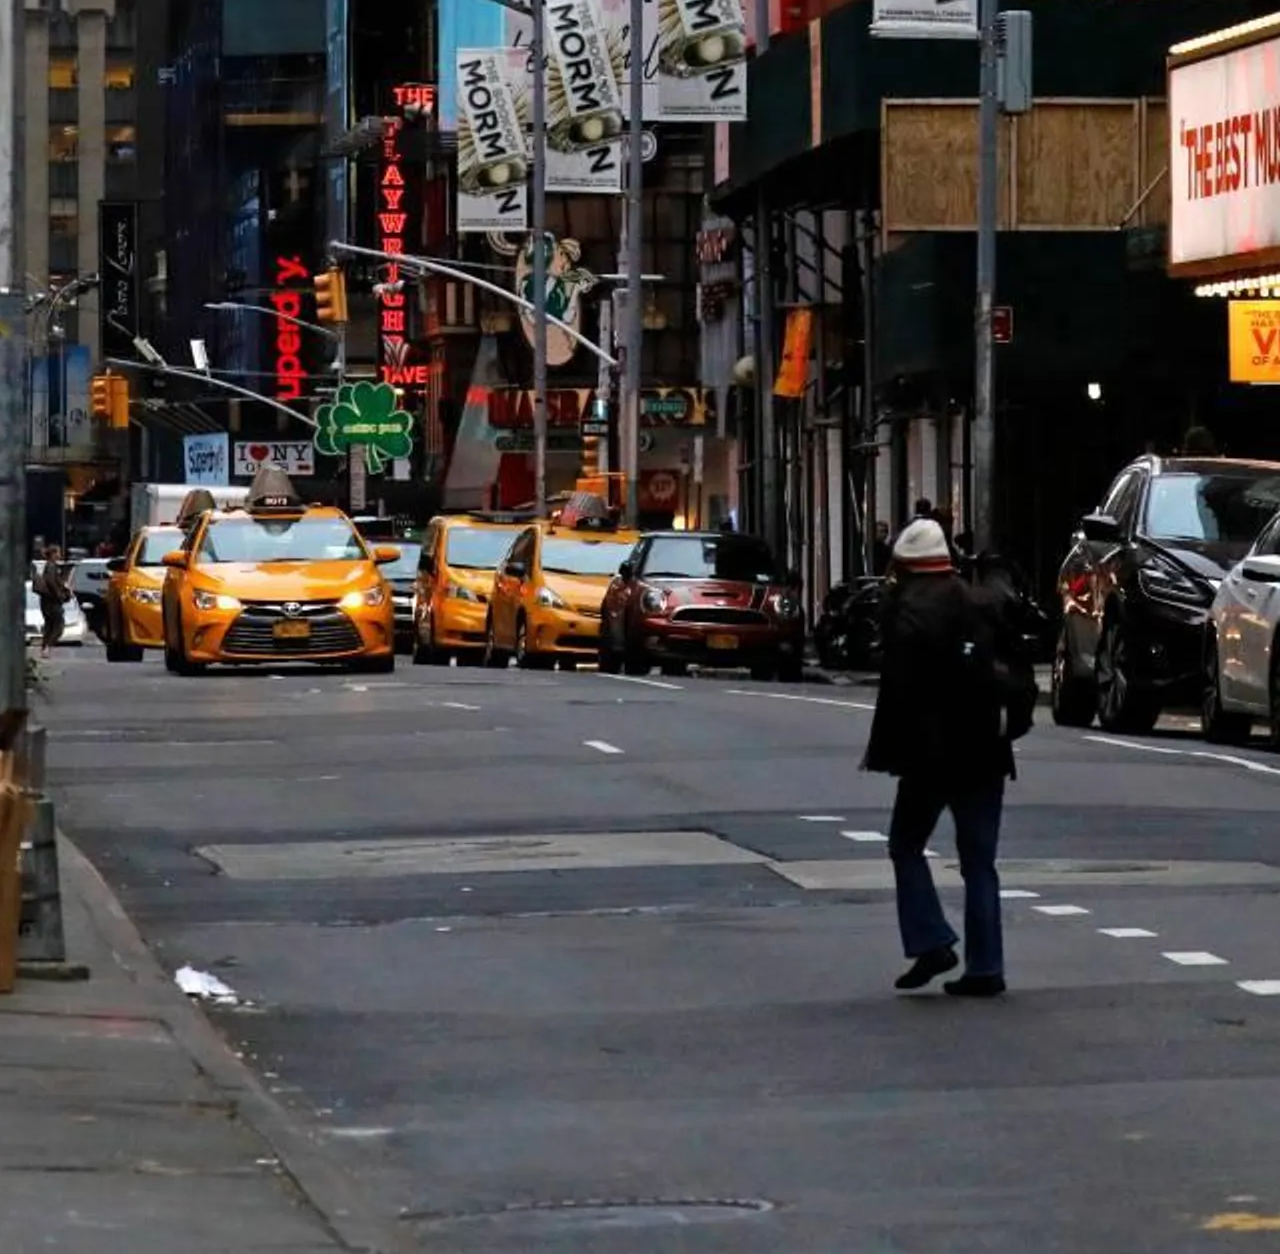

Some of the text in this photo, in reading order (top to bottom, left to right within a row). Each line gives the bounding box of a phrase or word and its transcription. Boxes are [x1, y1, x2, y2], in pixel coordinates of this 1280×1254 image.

[392, 87, 434, 110] THE
[1215, 113, 1252, 195] BEST
[1252, 356, 1269, 366] OF
